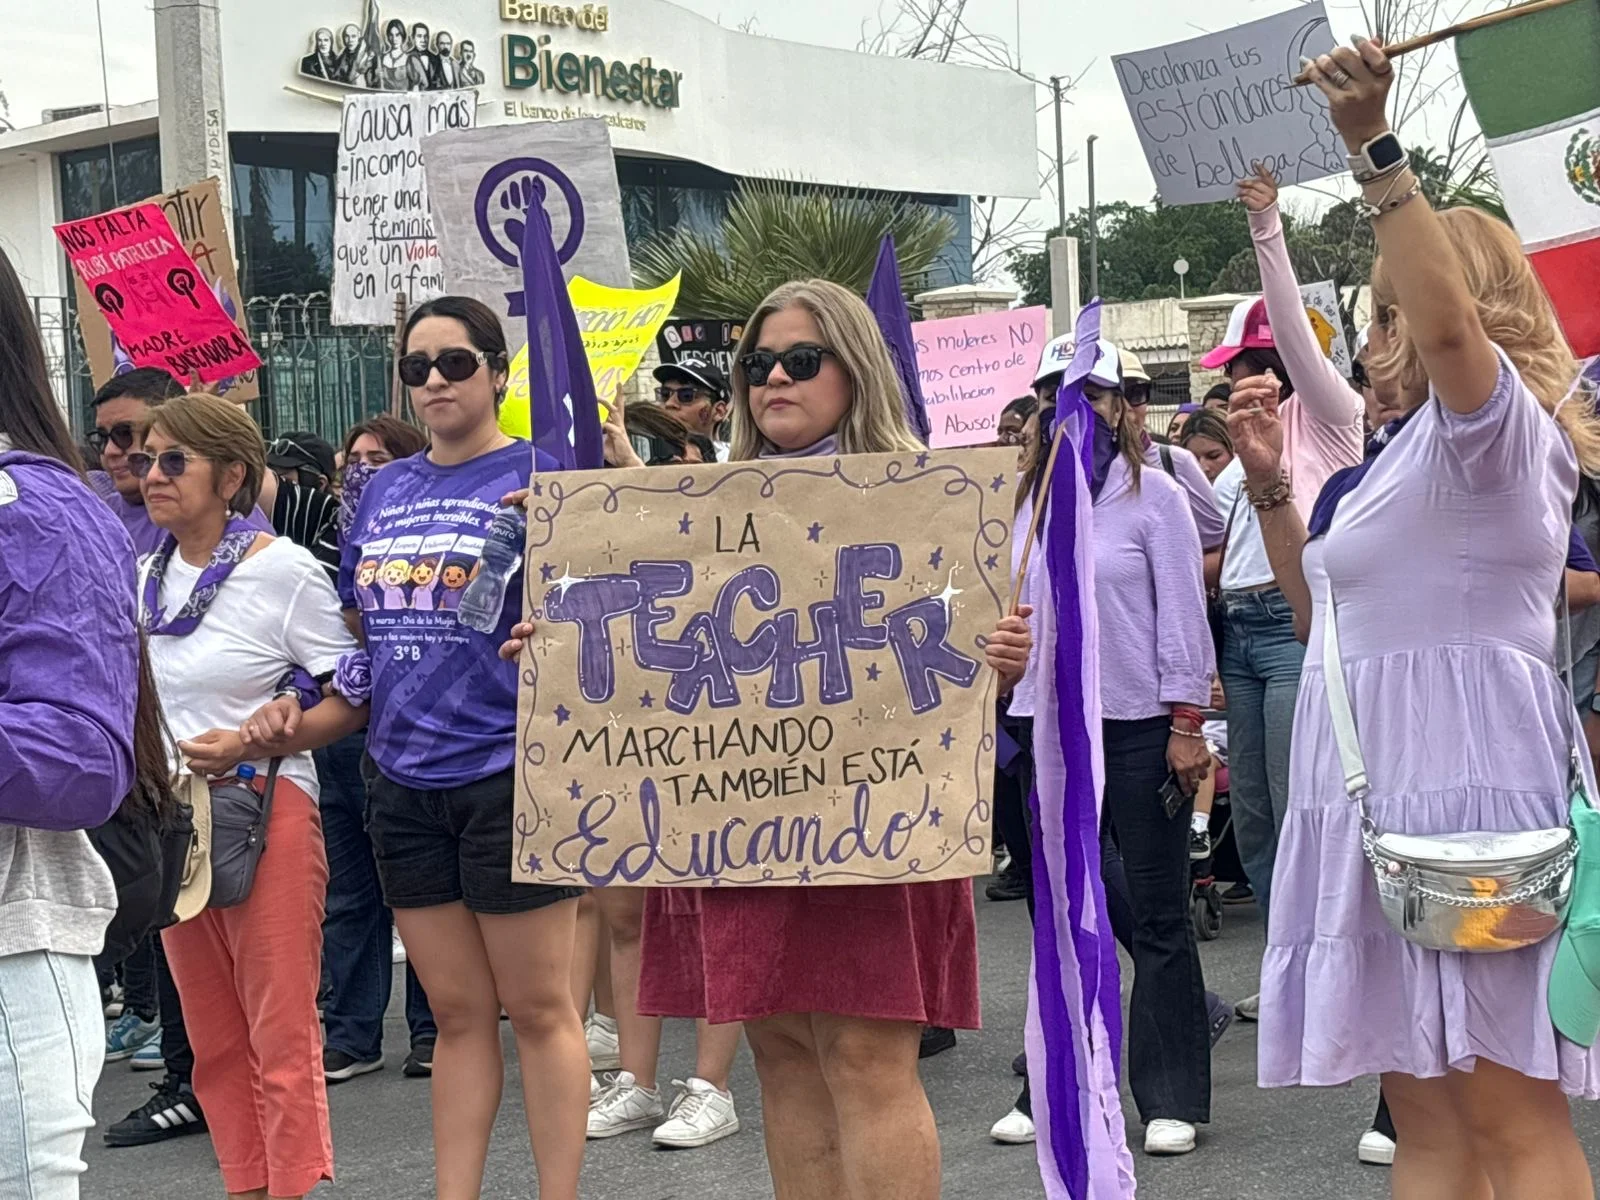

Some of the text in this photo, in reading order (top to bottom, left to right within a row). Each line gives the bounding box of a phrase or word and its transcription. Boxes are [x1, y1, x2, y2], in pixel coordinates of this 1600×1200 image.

[500, 0, 609, 32] Banco del
[502, 33, 683, 111] Bienestar
[1225, 43, 1262, 69] tus
[344, 96, 470, 151] Causa más
[504, 101, 516, 117] El
[521, 101, 559, 120] banco
[1154, 148, 1187, 177] de
[337, 187, 388, 222] tener
[394, 188, 421, 211] una
[60, 209, 151, 255] NOS FALTA
[109, 235, 176, 270] PATRICIA
[337, 244, 369, 272] que
[379, 243, 402, 266] un
[353, 271, 376, 300] en
[384, 266, 403, 294] la
[127, 328, 191, 360] MADRE
[1008, 321, 1034, 349] NO
[1004, 351, 1027, 369] de
[944, 413, 997, 435] Abuso!
[715, 512, 761, 554] LA
[543, 542, 982, 715] TEACHER
[562, 714, 834, 768] MARCHANDO
[663, 738, 925, 806] TAMBIÉN ESTÁ
[551, 776, 931, 888] Educando
